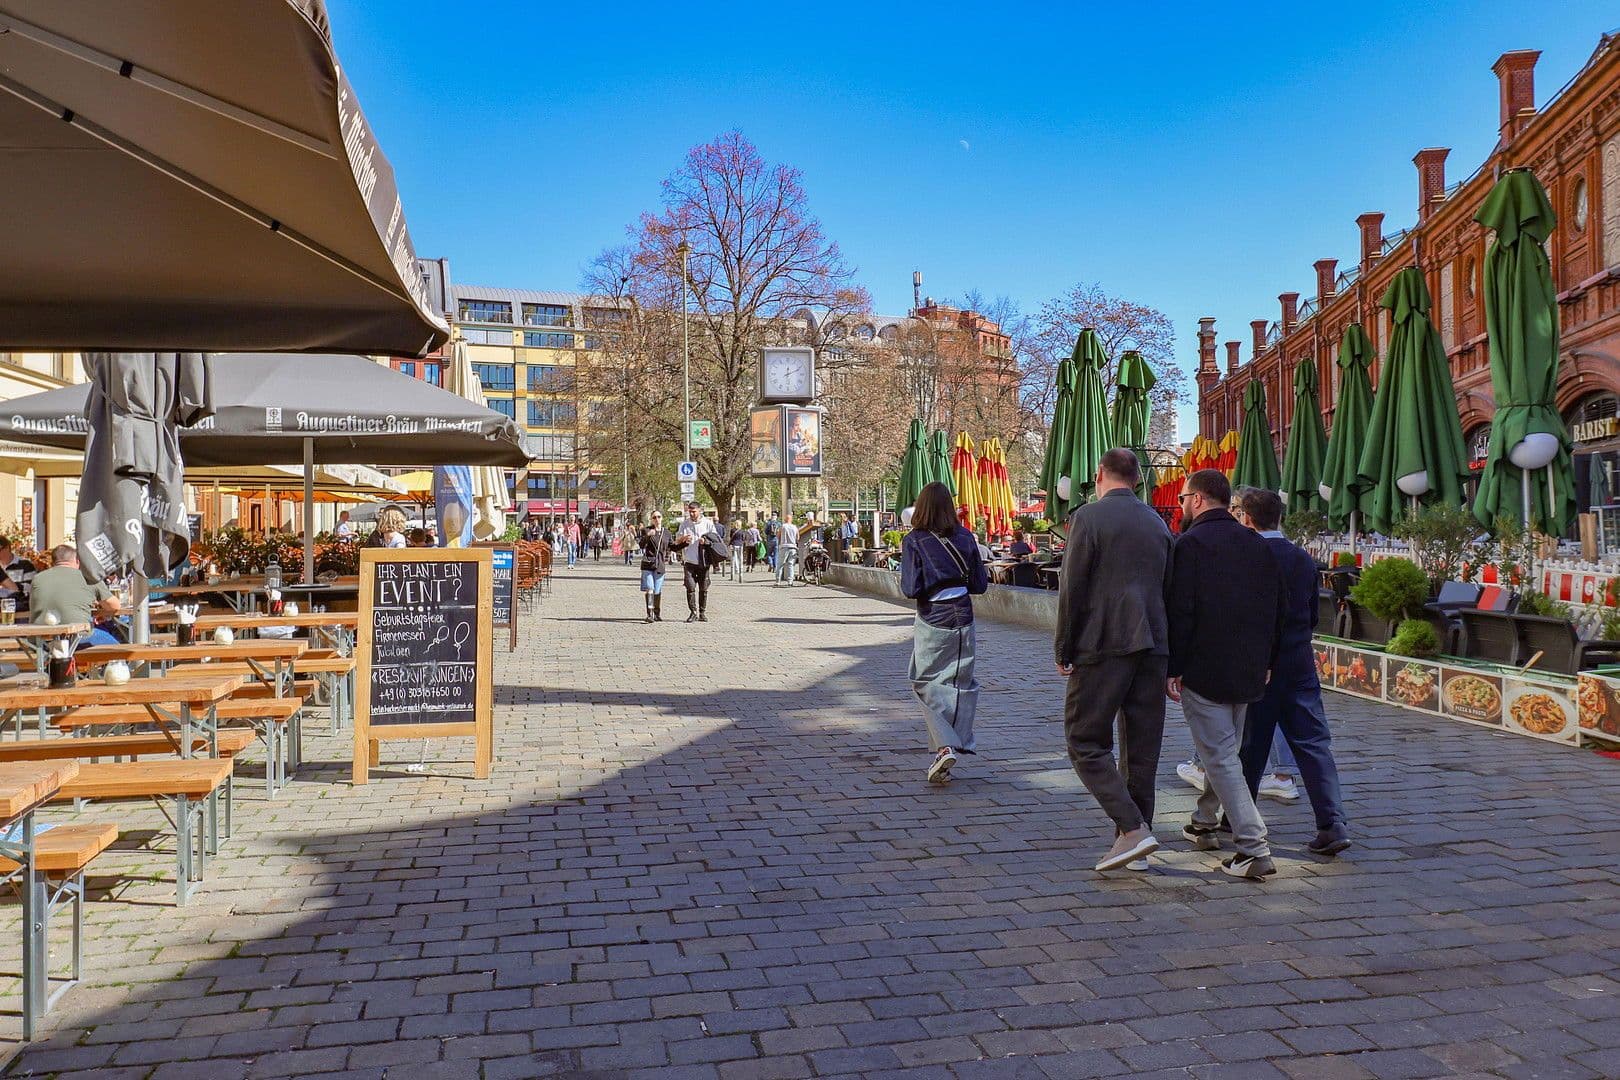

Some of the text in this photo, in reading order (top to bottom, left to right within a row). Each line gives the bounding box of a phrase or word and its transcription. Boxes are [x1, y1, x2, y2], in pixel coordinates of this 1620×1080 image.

[11, 415, 90, 432] Augustin
[377, 562, 463, 579] IHR PLANT EIN
[380, 579, 447, 605] EVENT
